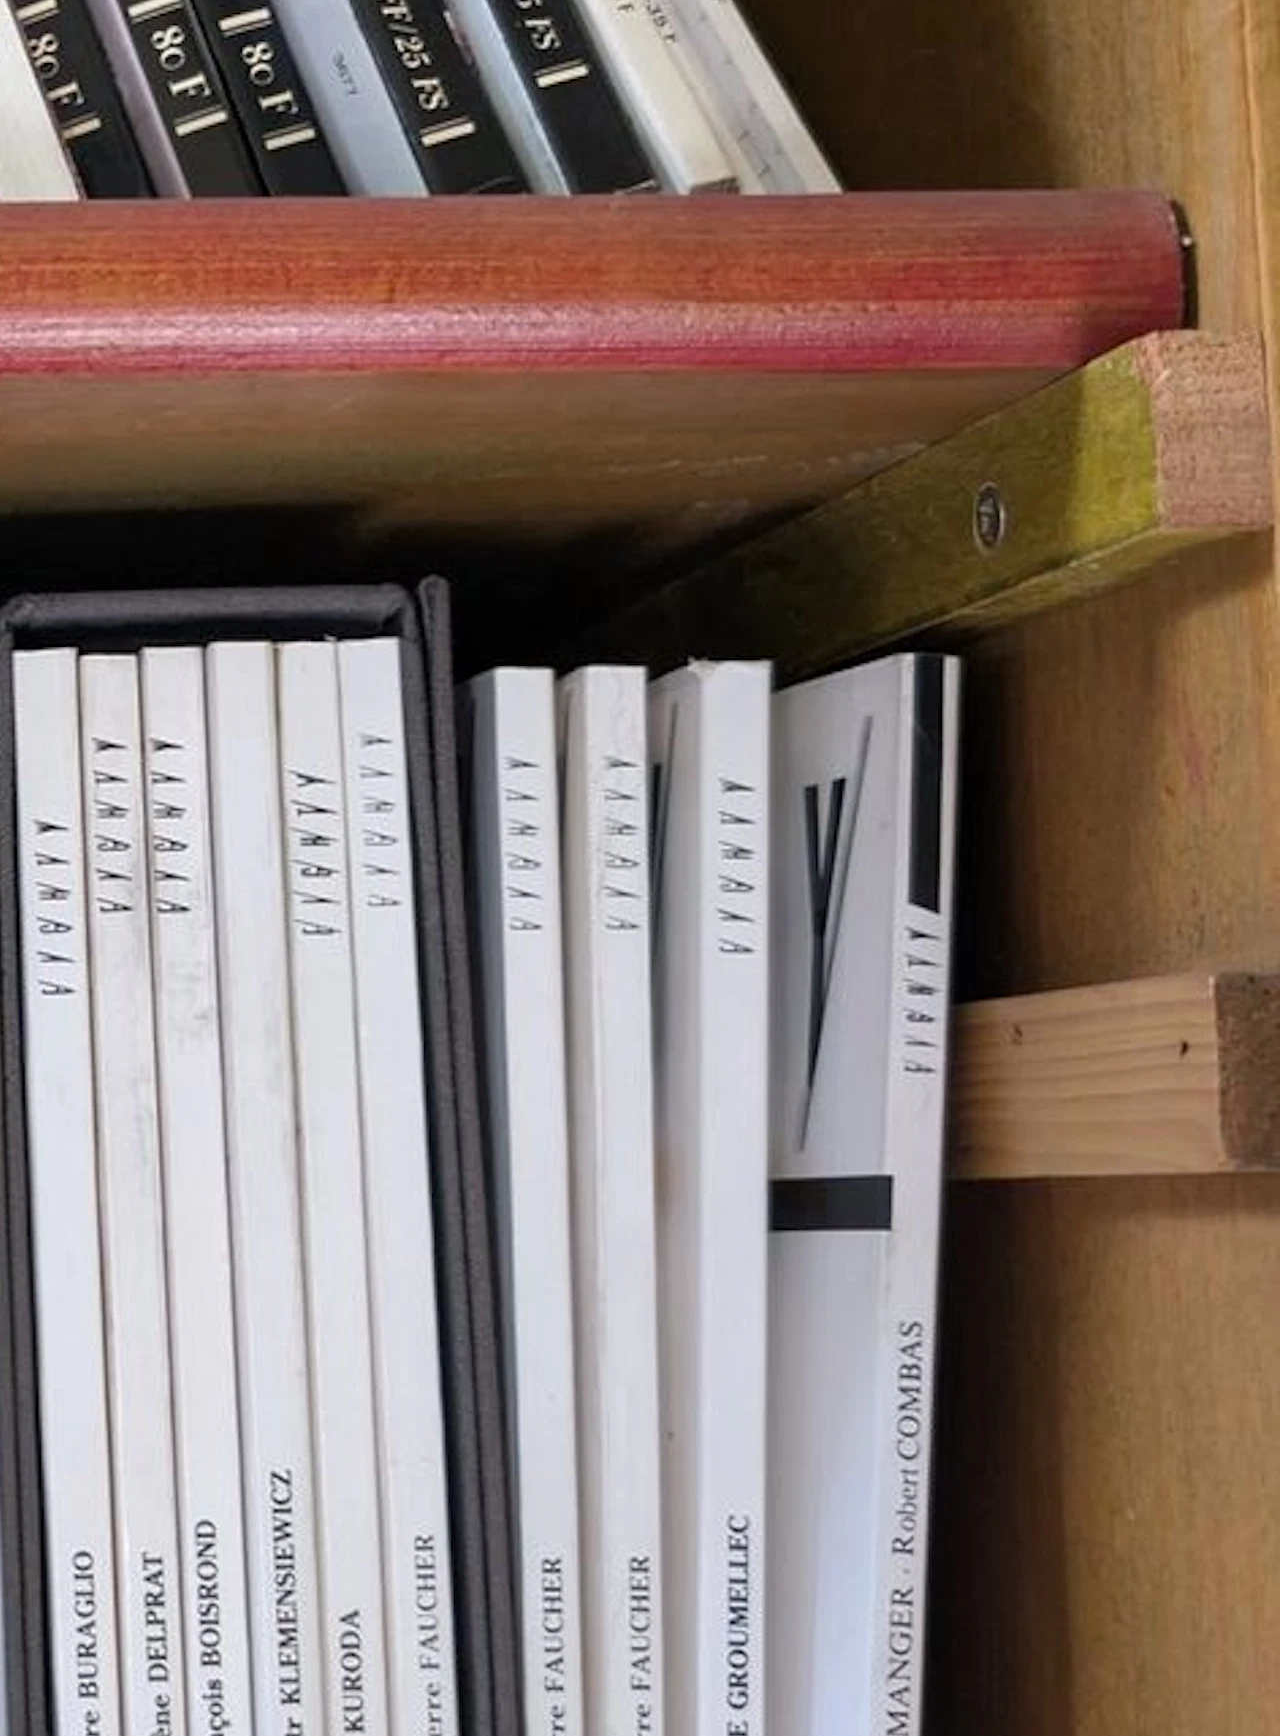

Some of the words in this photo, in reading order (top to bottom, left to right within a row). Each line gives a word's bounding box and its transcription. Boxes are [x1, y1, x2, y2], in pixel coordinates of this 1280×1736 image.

[410, 77, 449, 110] FS
[896, 1320, 923, 1461] COMBAS
[891, 1468, 919, 1555] Robert
[72, 1550, 99, 1698] BURAGLIO
[726, 1514, 749, 1710] GROUMELLEC
